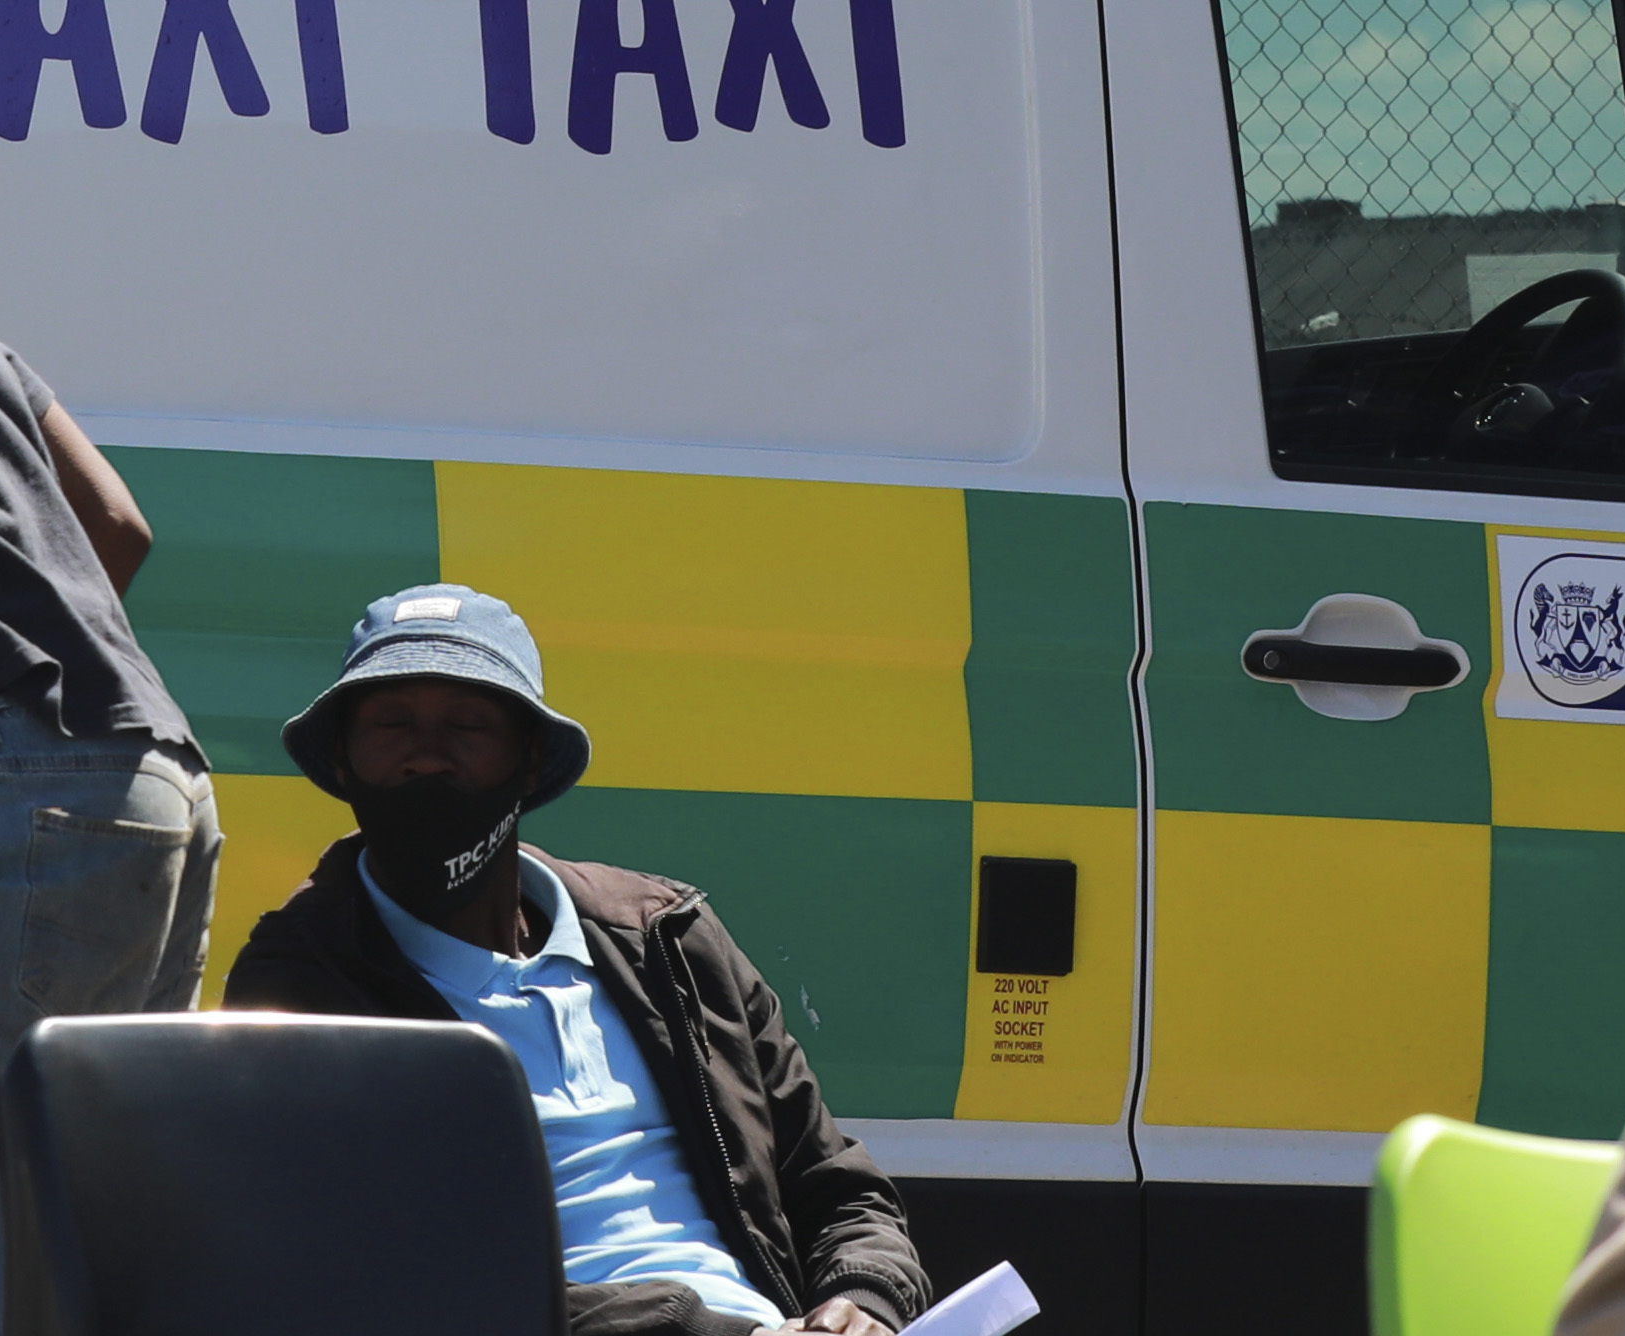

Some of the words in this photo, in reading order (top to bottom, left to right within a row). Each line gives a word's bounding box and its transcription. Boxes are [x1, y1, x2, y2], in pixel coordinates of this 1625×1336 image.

[444, 840, 485, 879] TPC
[994, 978, 1015, 994] 220
[1017, 979, 1049, 994] VOLT
[992, 1000, 1010, 1014] AC
[1013, 1000, 1049, 1015] INPUT
[995, 1021, 1045, 1036] SOCKET
[994, 1041, 1013, 1050] WITH
[1015, 1041, 1043, 1051] POWER
[991, 1053, 1002, 1062] ON
[1004, 1054, 1045, 1064] INDICATOR
